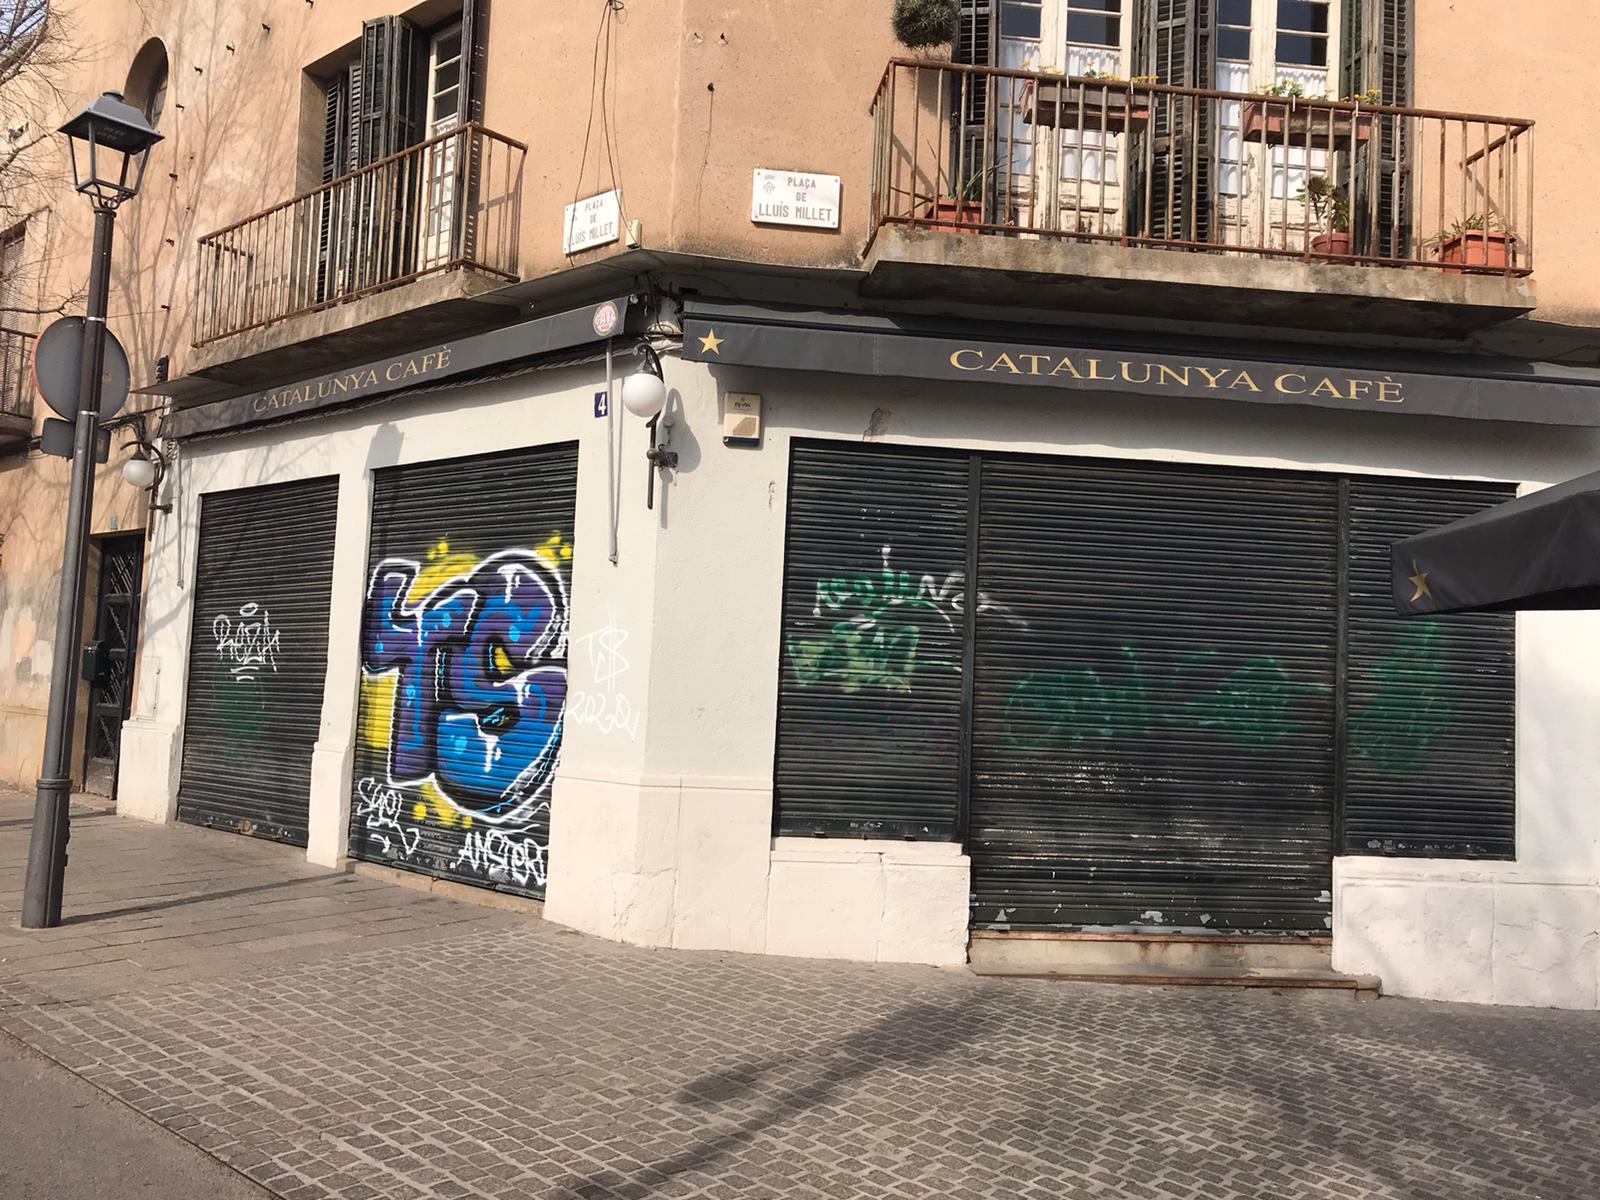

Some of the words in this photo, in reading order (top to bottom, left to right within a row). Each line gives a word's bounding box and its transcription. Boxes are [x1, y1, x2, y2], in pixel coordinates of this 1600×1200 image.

[787, 177, 816, 189] PLAÇA
[796, 192, 807, 202] DE
[590, 213, 597, 224] DE
[795, 206, 832, 221] MILLET
[589, 222, 613, 240] MILLET
[253, 368, 378, 412] CATALUNYA
[385, 346, 451, 382] CAFÈ
[949, 347, 1263, 393] CATALUNYA
[1273, 373, 1405, 404] CAFÈ
[598, 393, 606, 415] 4
